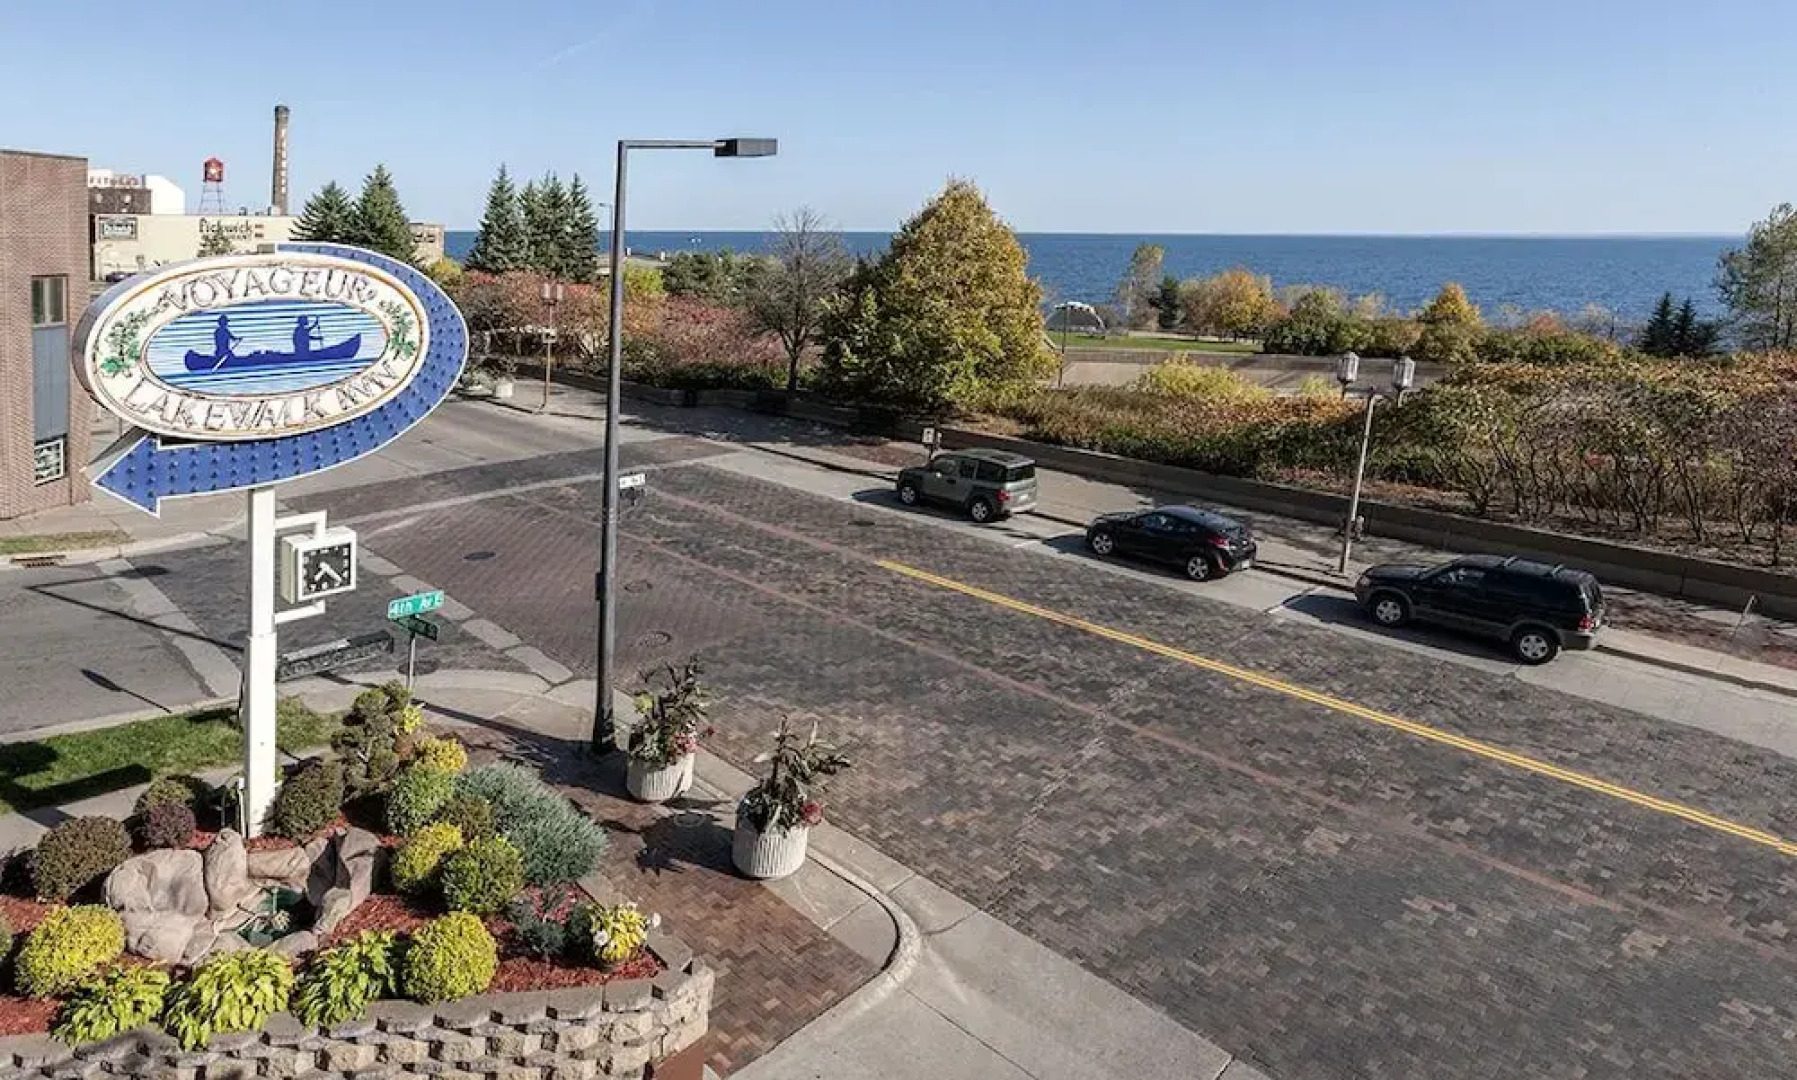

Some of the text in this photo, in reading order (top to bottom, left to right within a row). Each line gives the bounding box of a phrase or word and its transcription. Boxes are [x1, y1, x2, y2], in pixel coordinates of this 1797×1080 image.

[161, 267, 374, 310] VOYAGEUR
[123, 360, 398, 431] LAKEWALK INN
